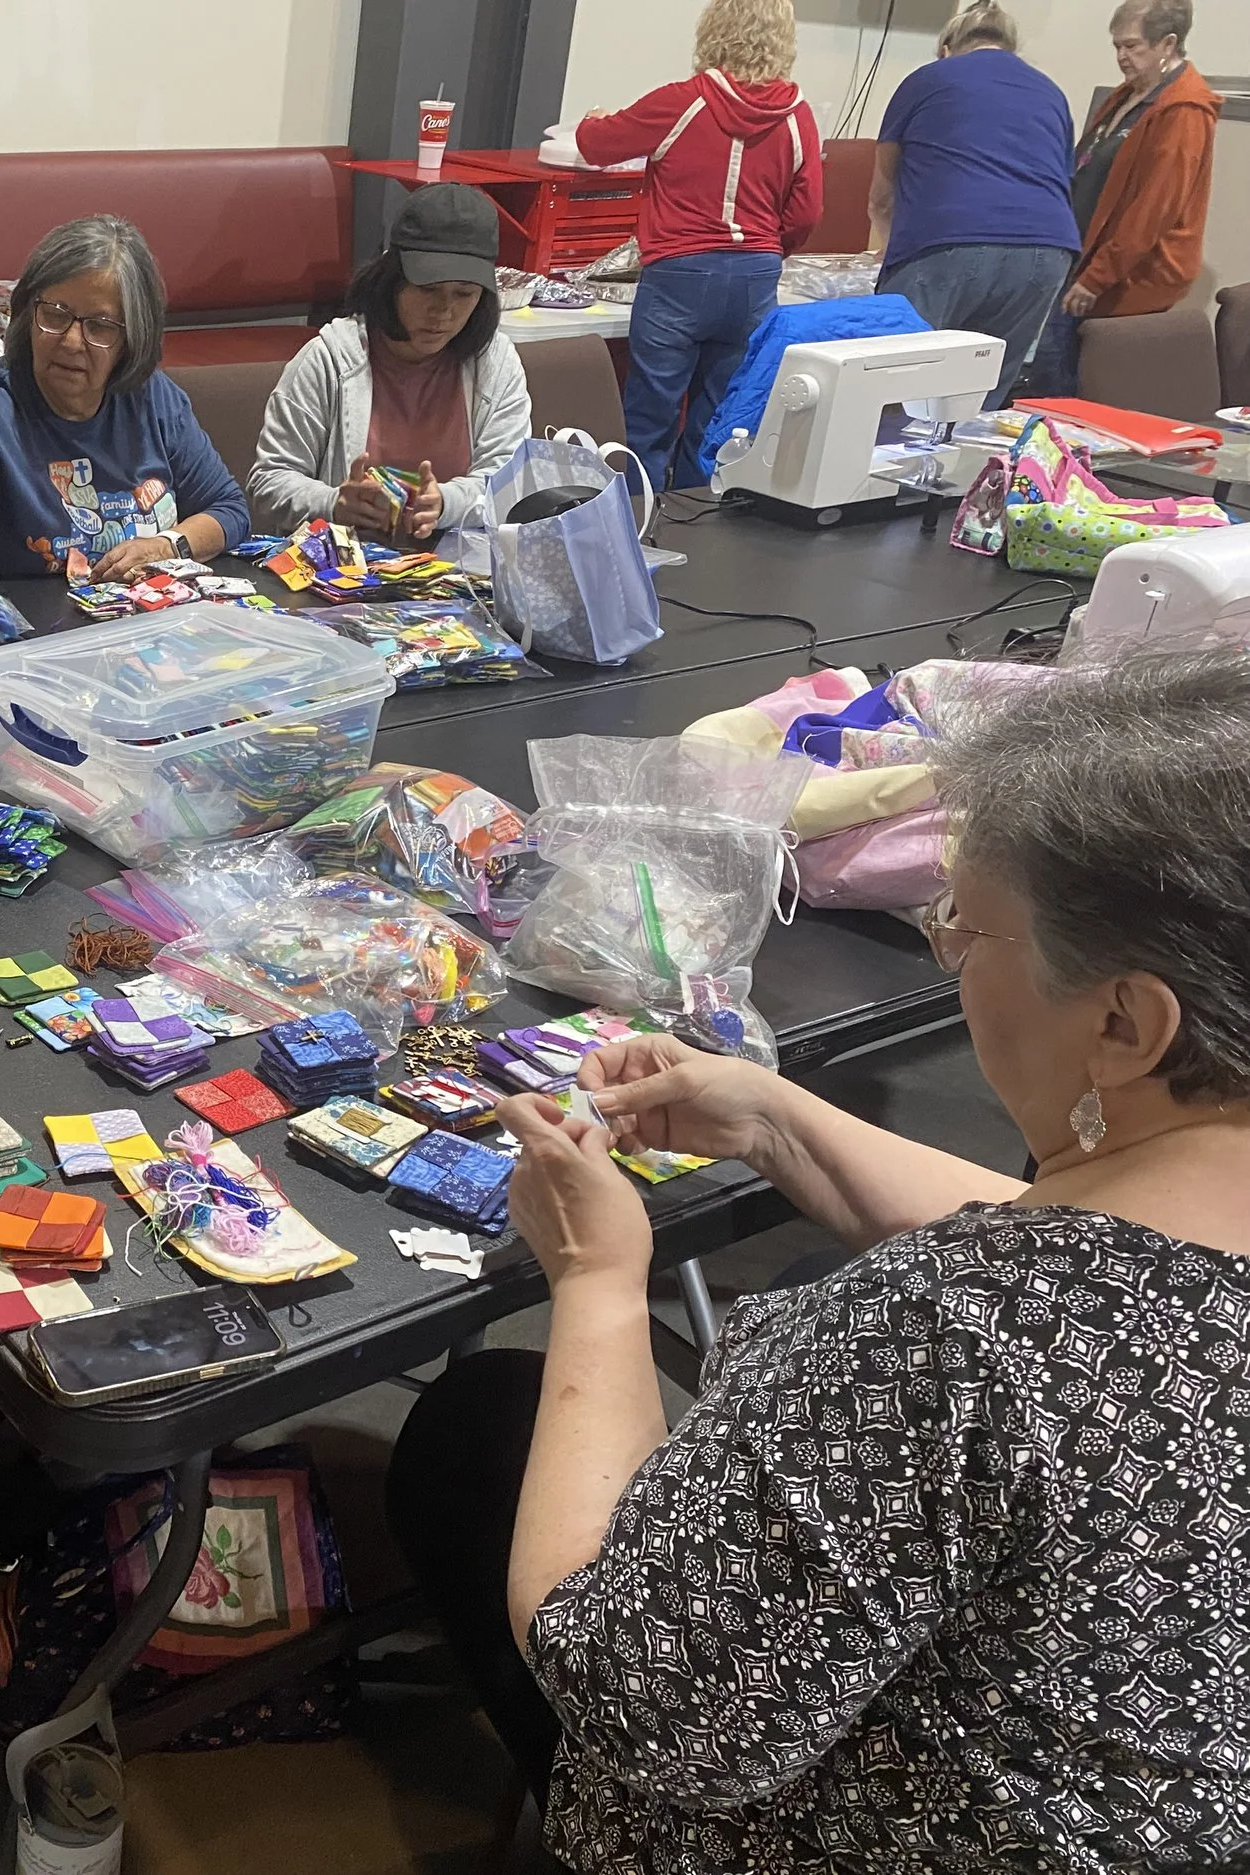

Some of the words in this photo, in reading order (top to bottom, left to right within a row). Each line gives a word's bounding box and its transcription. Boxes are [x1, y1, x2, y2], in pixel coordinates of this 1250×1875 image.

[974, 349, 991, 358] PFAFF
[100, 498, 137, 514] family
[55, 534, 87, 549] sweet
[202, 1302, 247, 1346] 11:09
